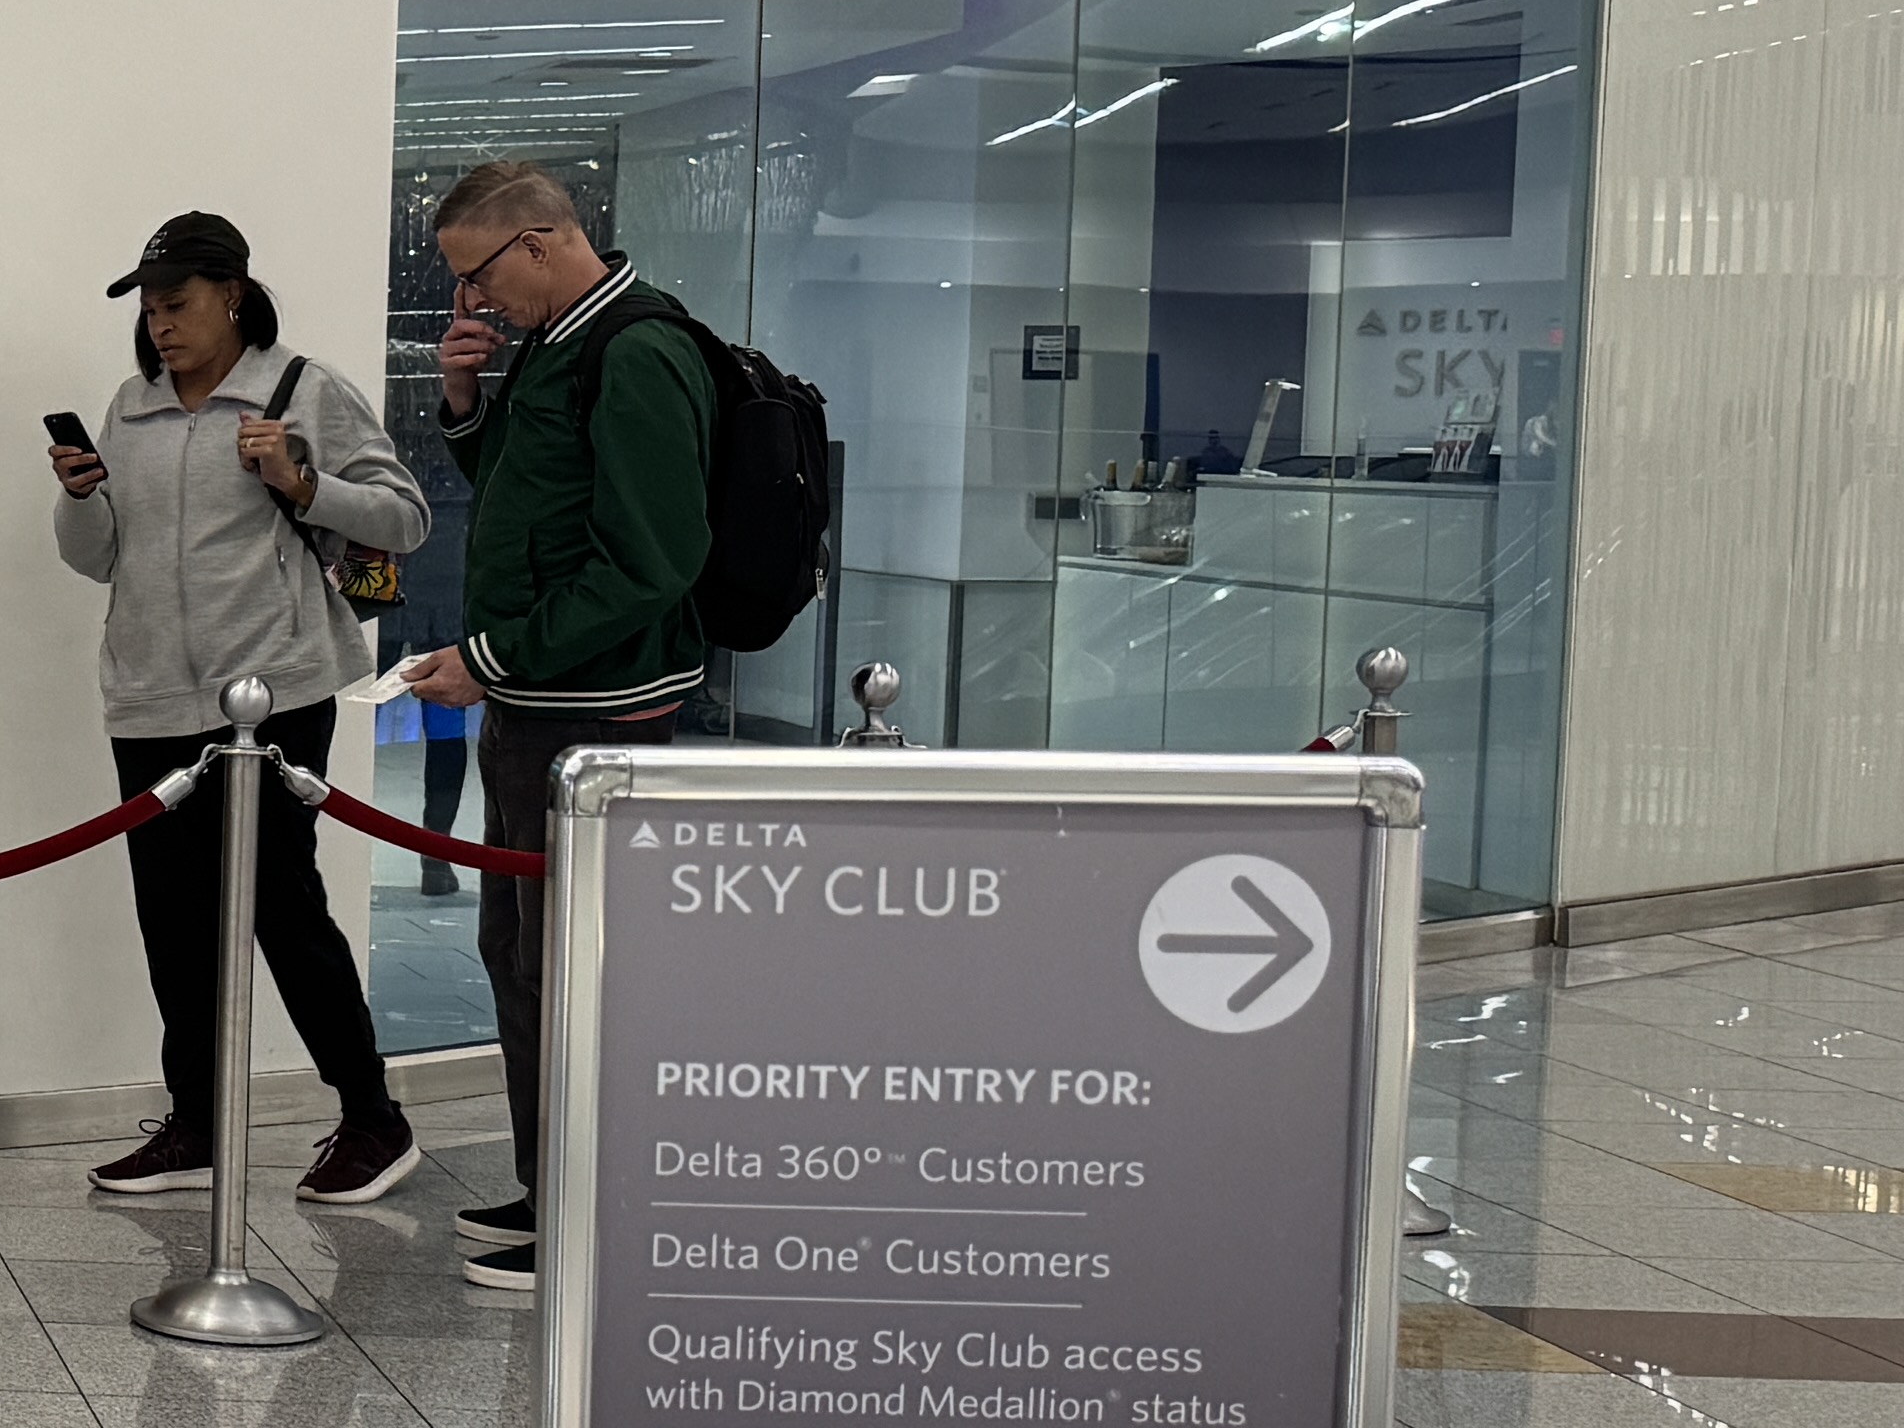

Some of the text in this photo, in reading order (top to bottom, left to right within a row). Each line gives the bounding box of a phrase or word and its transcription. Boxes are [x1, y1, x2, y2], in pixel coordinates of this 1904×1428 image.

[674, 822, 807, 848] DELTA
[670, 864, 803, 914] SKY
[656, 1061, 1151, 1106] PRIORITY ENTRY FOR:
[655, 1141, 763, 1178] Delta
[918, 1147, 1145, 1187] Customers
[652, 1232, 759, 1270] Delta
[885, 1238, 1111, 1279] Customers
[648, 1323, 1203, 1374] Qualifying Sky Club access
[645, 1377, 724, 1411] with
[737, 1379, 906, 1416] Diamond
[1131, 1392, 1247, 1426] status
